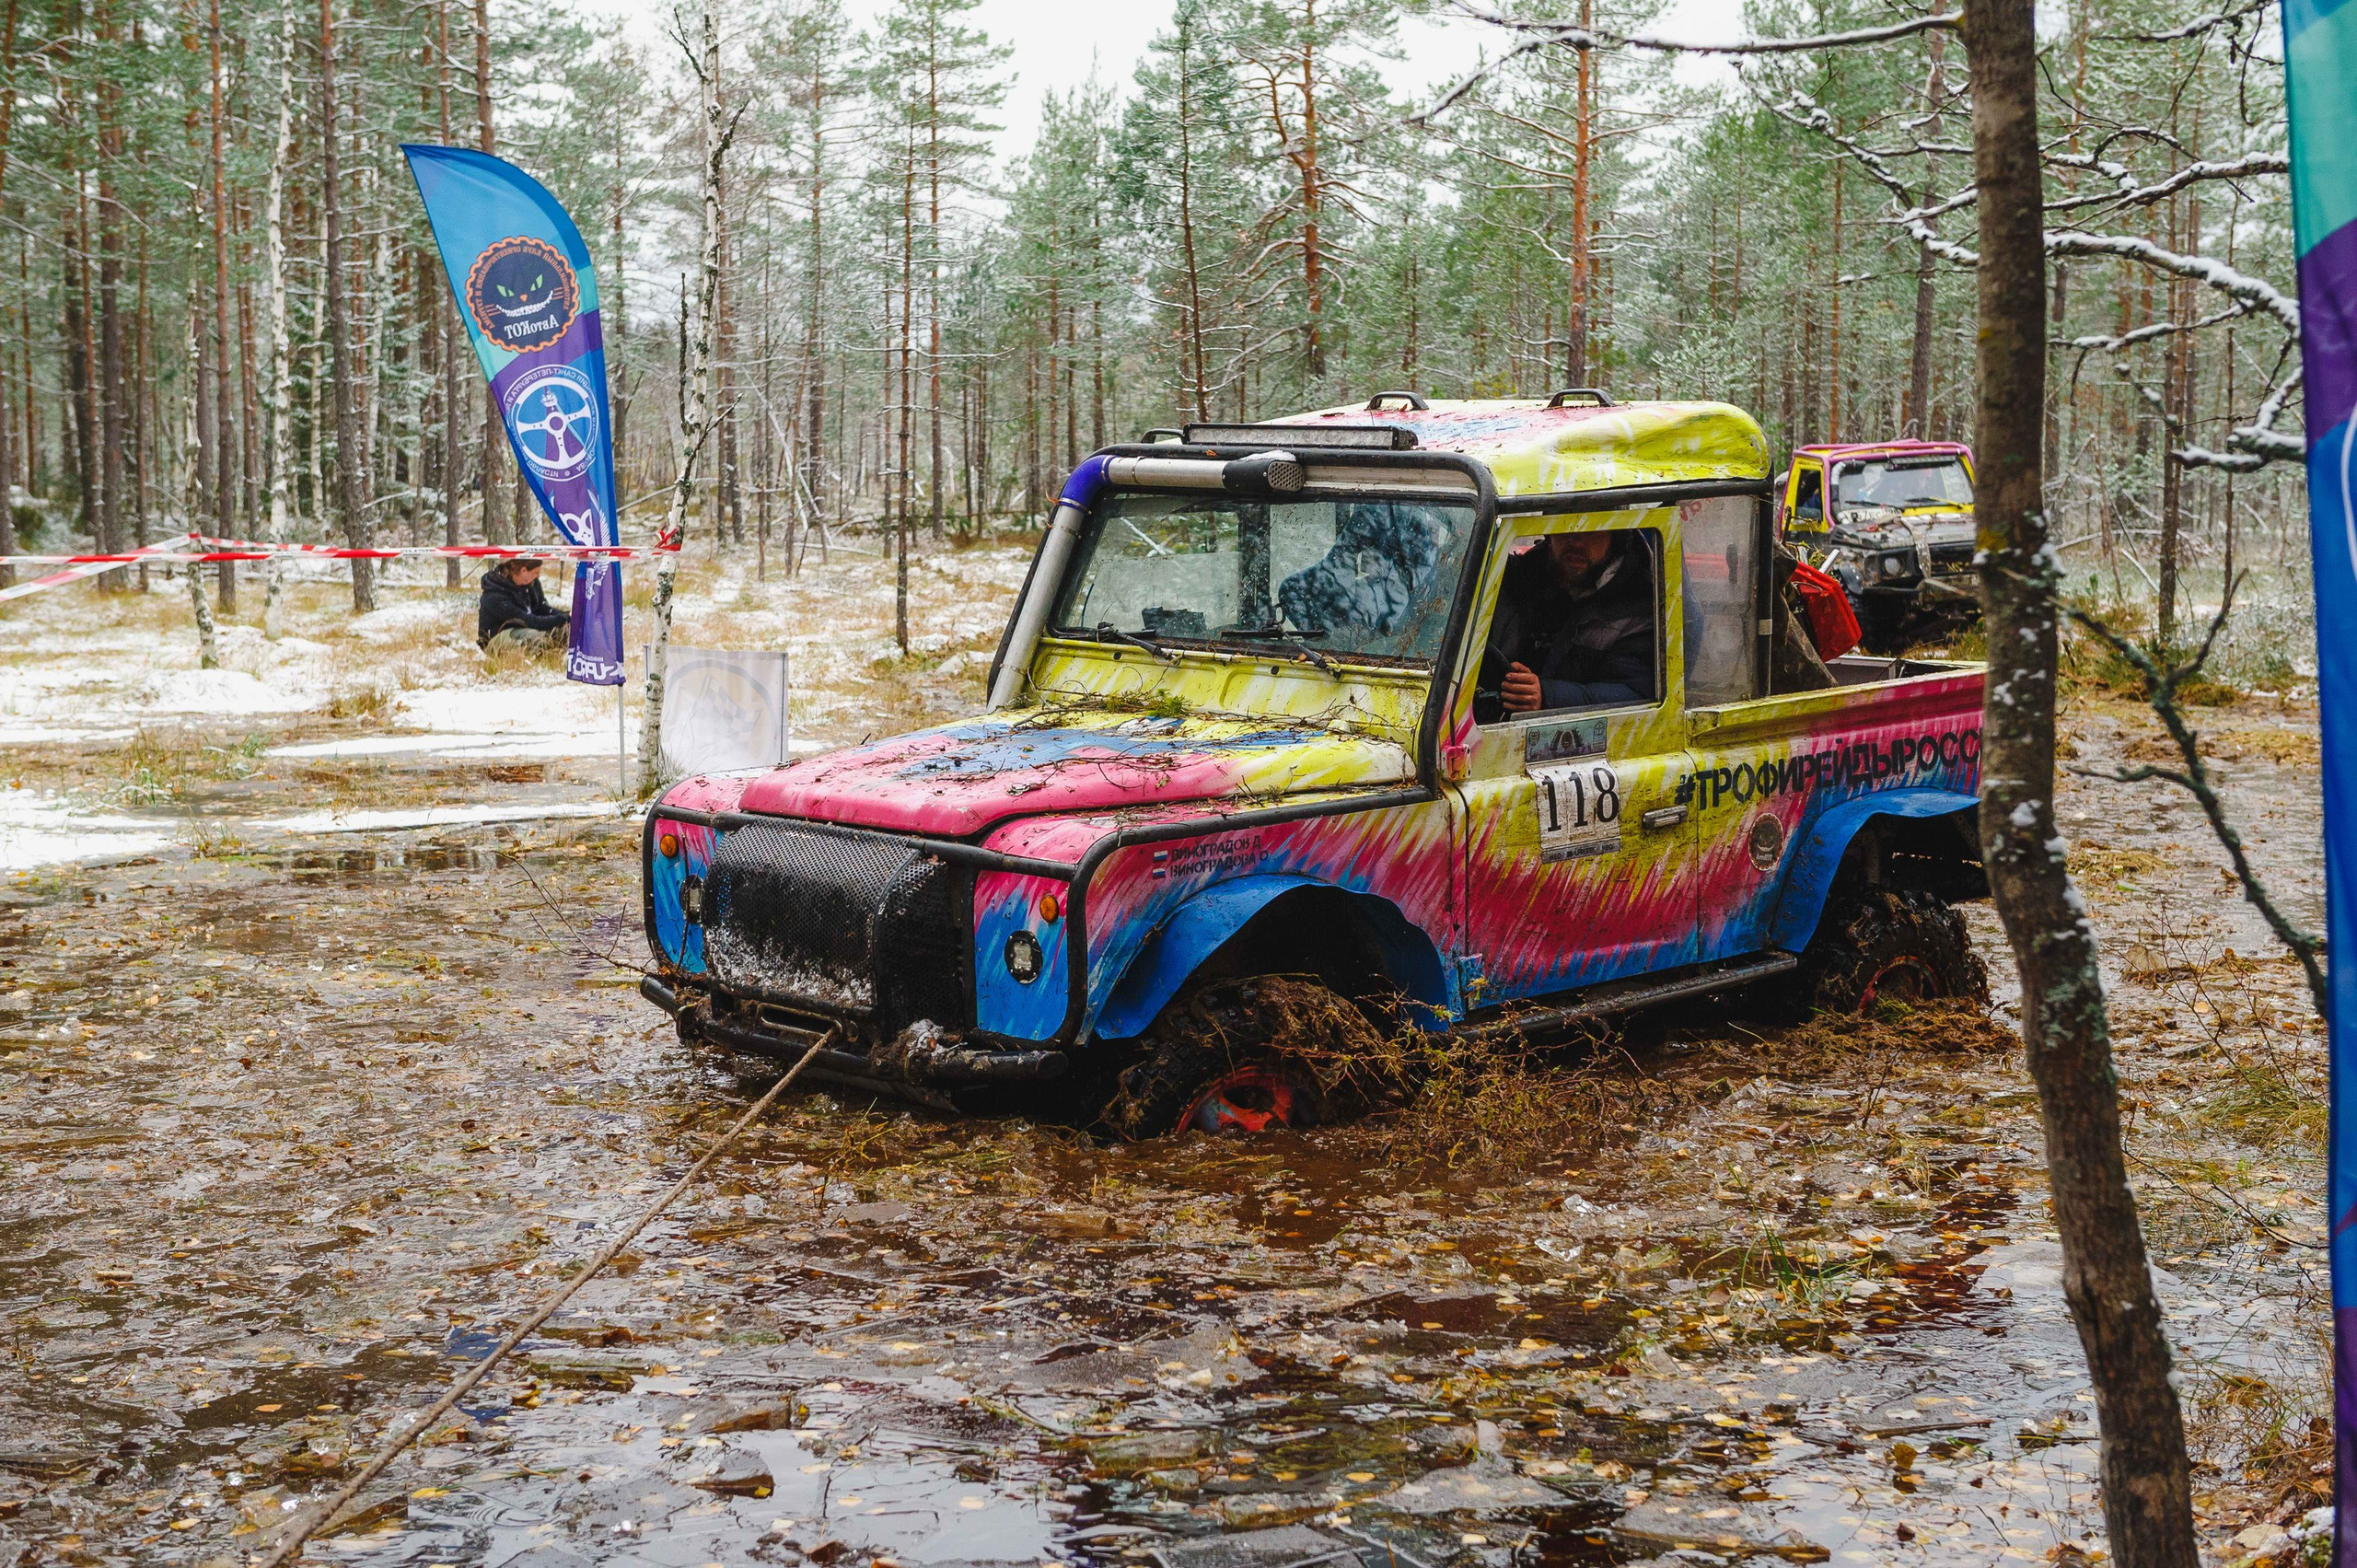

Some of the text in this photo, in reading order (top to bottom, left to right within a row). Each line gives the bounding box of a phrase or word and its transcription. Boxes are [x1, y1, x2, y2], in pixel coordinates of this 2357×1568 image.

[1674, 727, 1982, 811] #ТРОФИРЕЙДЫРОСС
[1541, 766, 1620, 831] 118
[1169, 850, 1269, 877] ВИНОГРАДОВА О
[1170, 835, 1261, 862] ВИНОГРАДОВ Д
